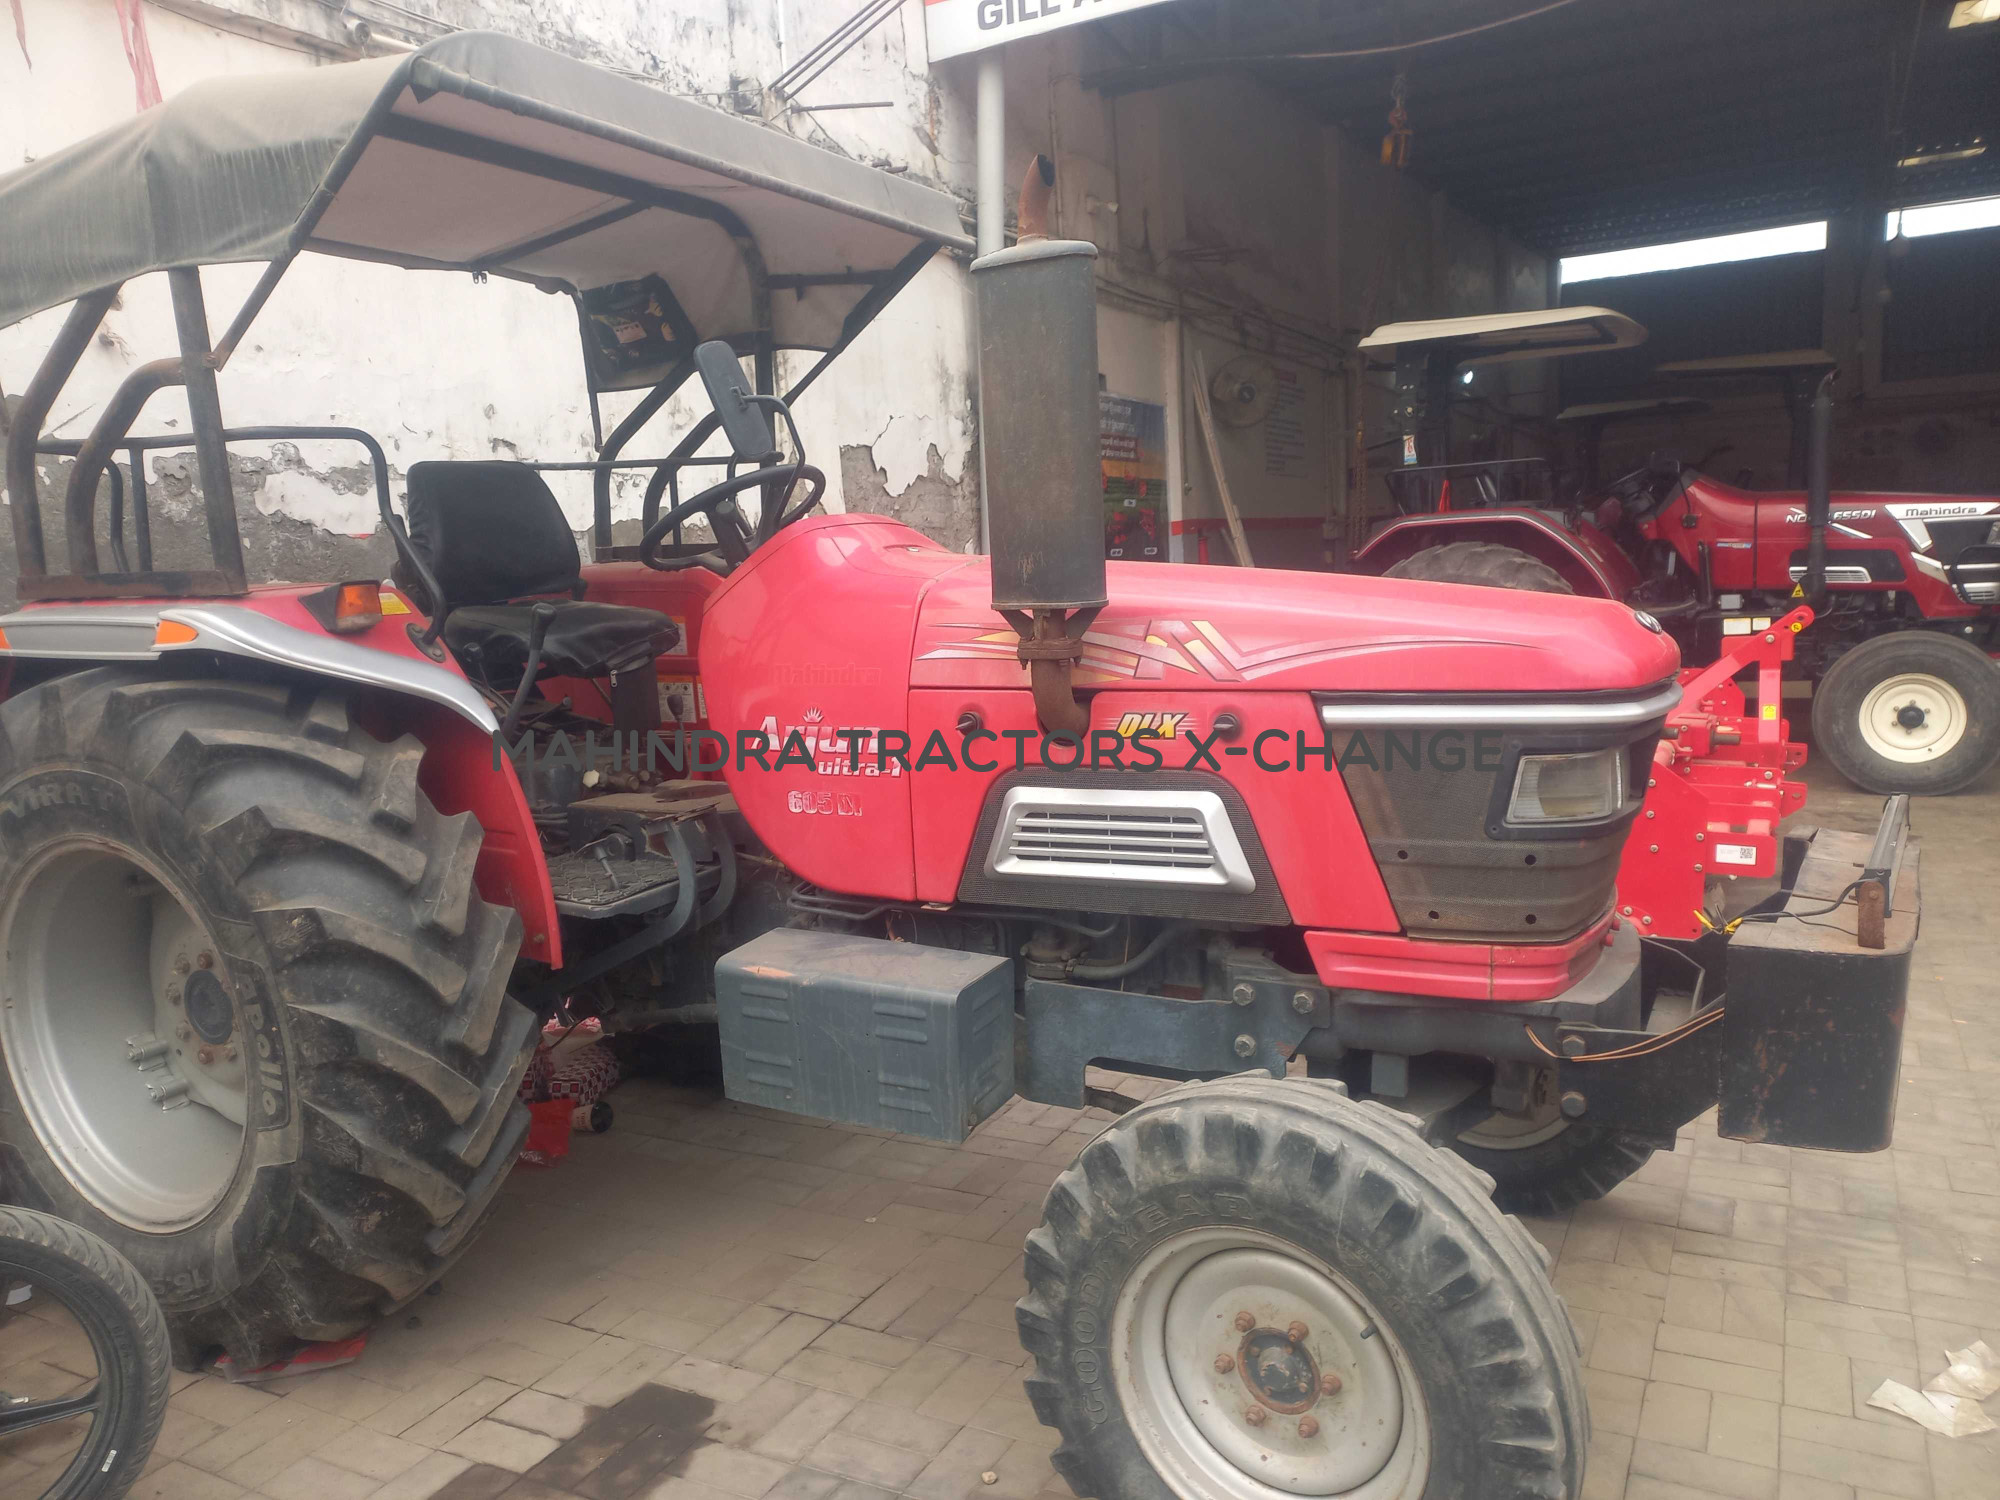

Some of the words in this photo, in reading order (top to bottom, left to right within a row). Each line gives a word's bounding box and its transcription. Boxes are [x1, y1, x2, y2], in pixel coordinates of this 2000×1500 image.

[977, 0, 1061, 30] GILL
[1833, 509, 1877, 520] 655DI
[1905, 505, 1978, 517] Mahindra
[1114, 712, 1189, 740] DLX
[787, 790, 834, 815] 605
